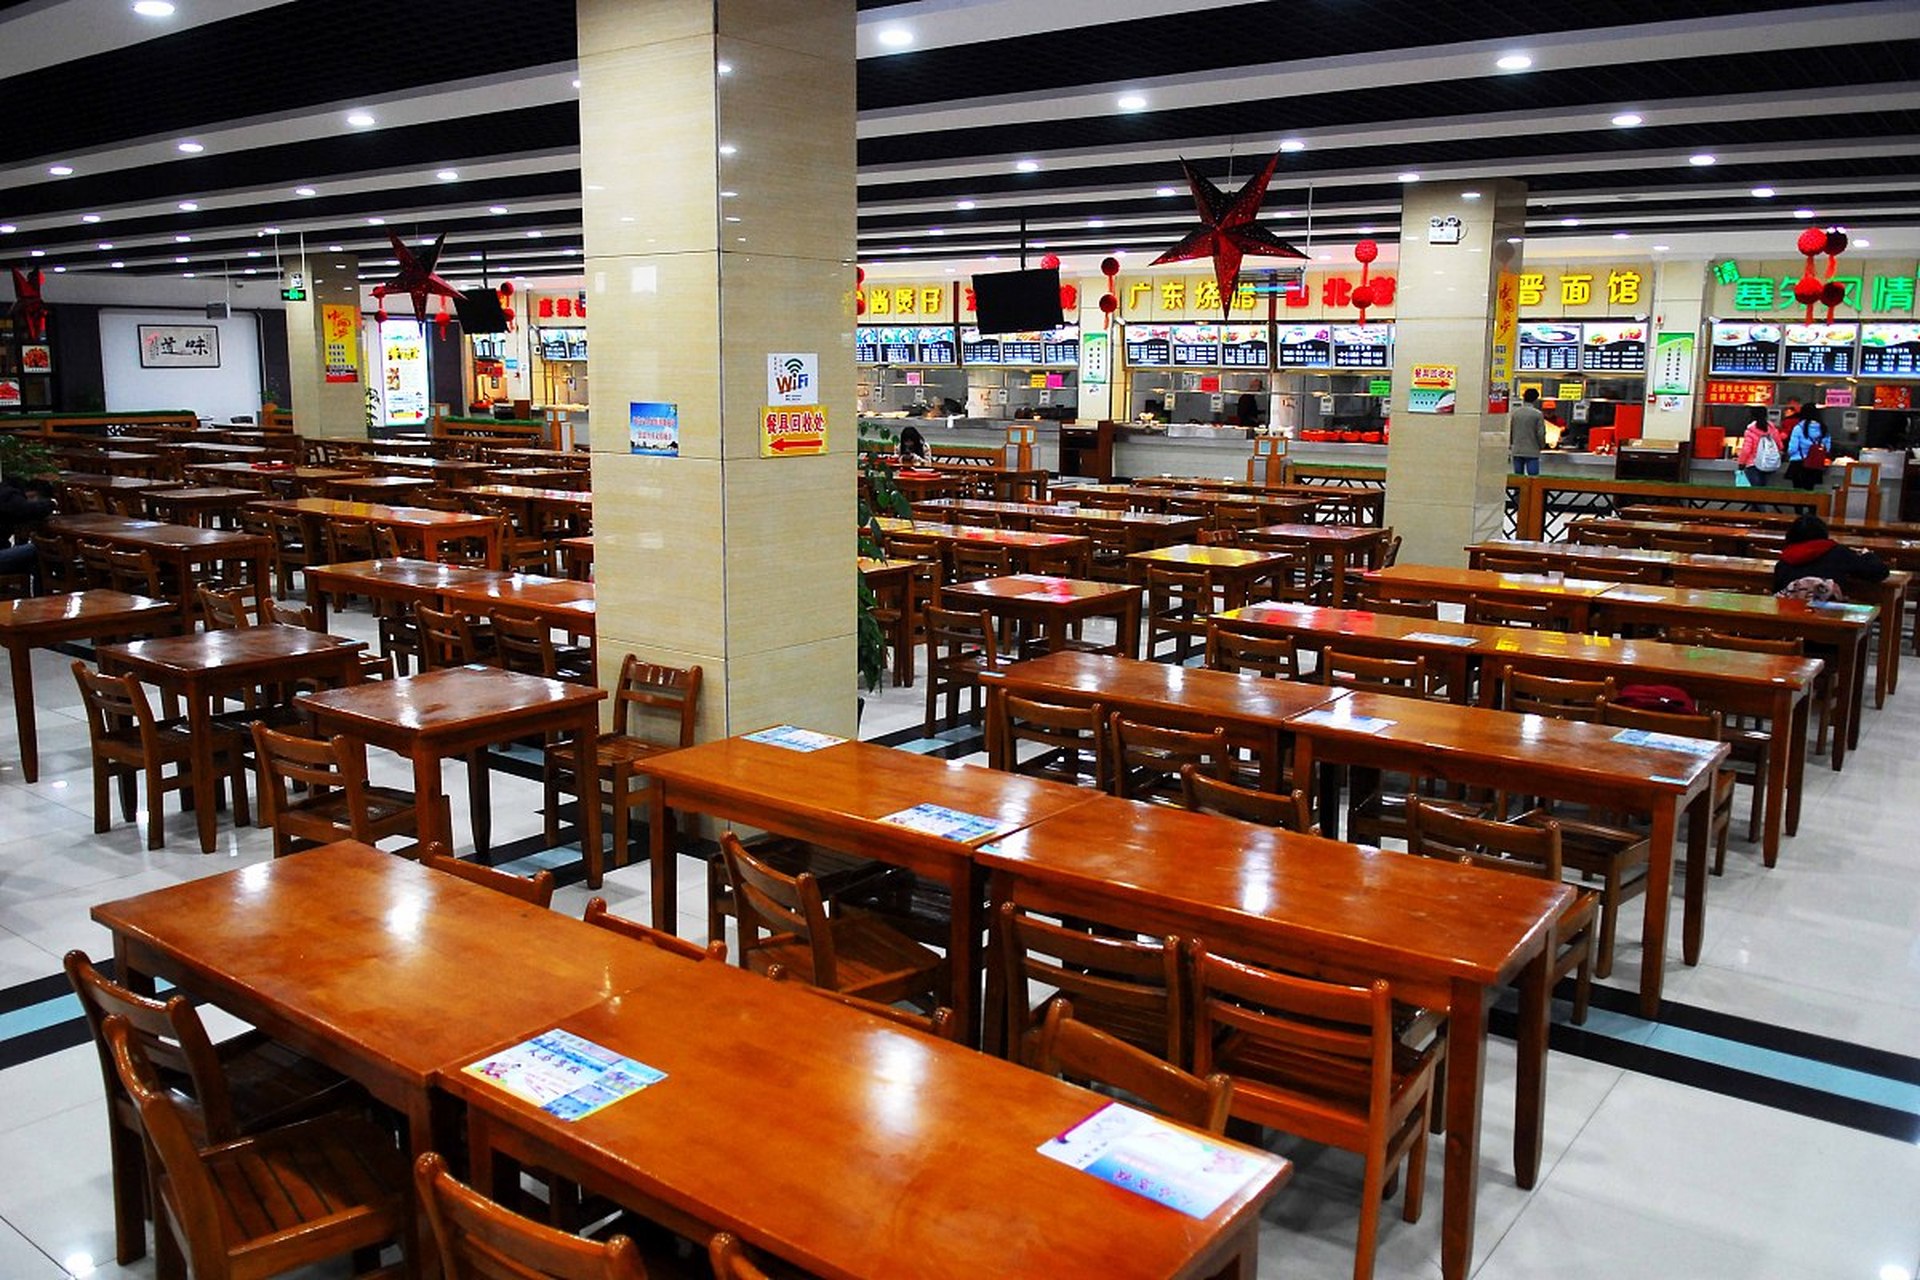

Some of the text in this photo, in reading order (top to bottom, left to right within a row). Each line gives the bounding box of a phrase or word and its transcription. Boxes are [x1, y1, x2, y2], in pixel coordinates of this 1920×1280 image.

[856, 287, 943, 314] 尚煲仔
[776, 372, 809, 394] WiFi
[767, 412, 825, 434] 餐具回收处
